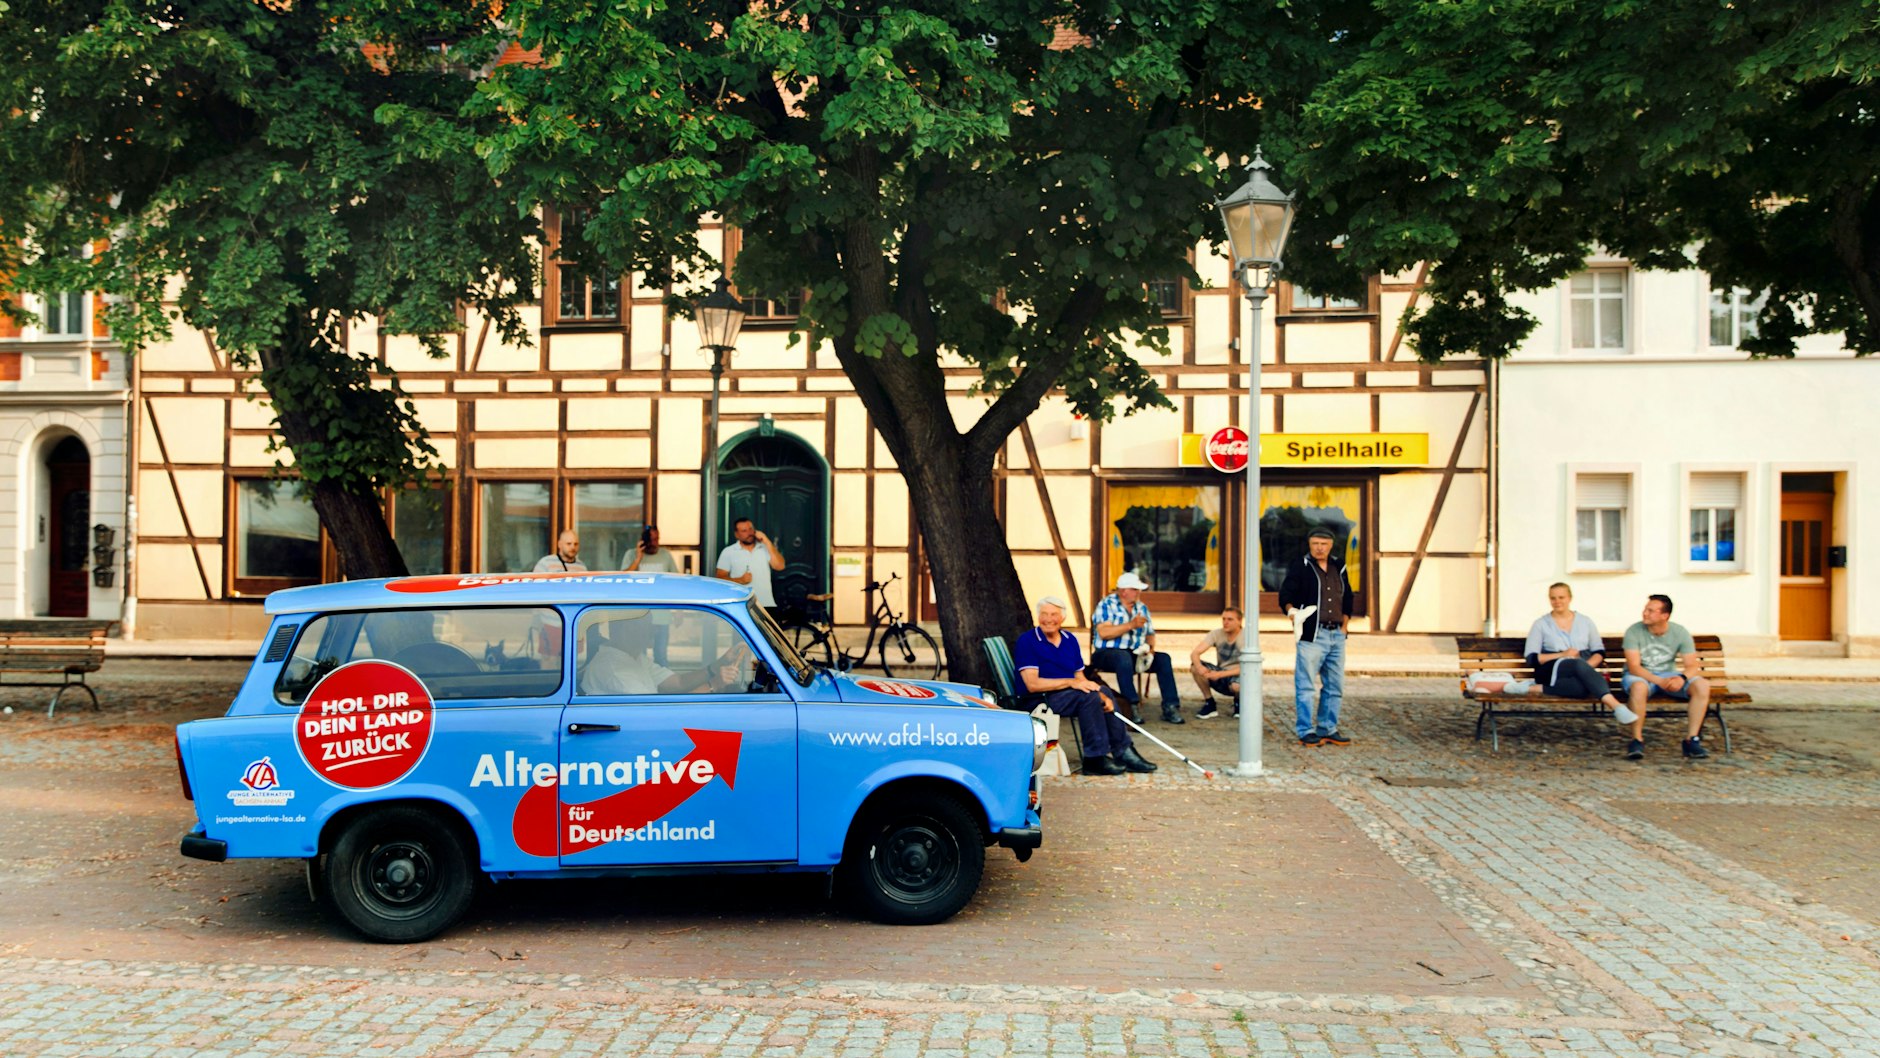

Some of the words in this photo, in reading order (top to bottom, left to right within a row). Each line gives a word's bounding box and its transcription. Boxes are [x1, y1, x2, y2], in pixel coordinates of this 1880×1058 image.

[1209, 440, 1248, 455] Coca-Col
[1287, 442, 1403, 461] Spielhalle
[458, 576, 655, 586] Deutschland
[321, 697, 367, 716] HOL
[373, 692, 409, 709] DIR
[305, 716, 356, 738] DEIN
[364, 710, 424, 730] LAND
[829, 723, 989, 746] www.afd-lsa.de
[321, 731, 412, 760] ZURÜCK
[470, 749, 714, 788] Alternative
[216, 814, 306, 824] jungealternative-lsa.de
[568, 806, 594, 821] für
[569, 820, 715, 843] Deutschland
